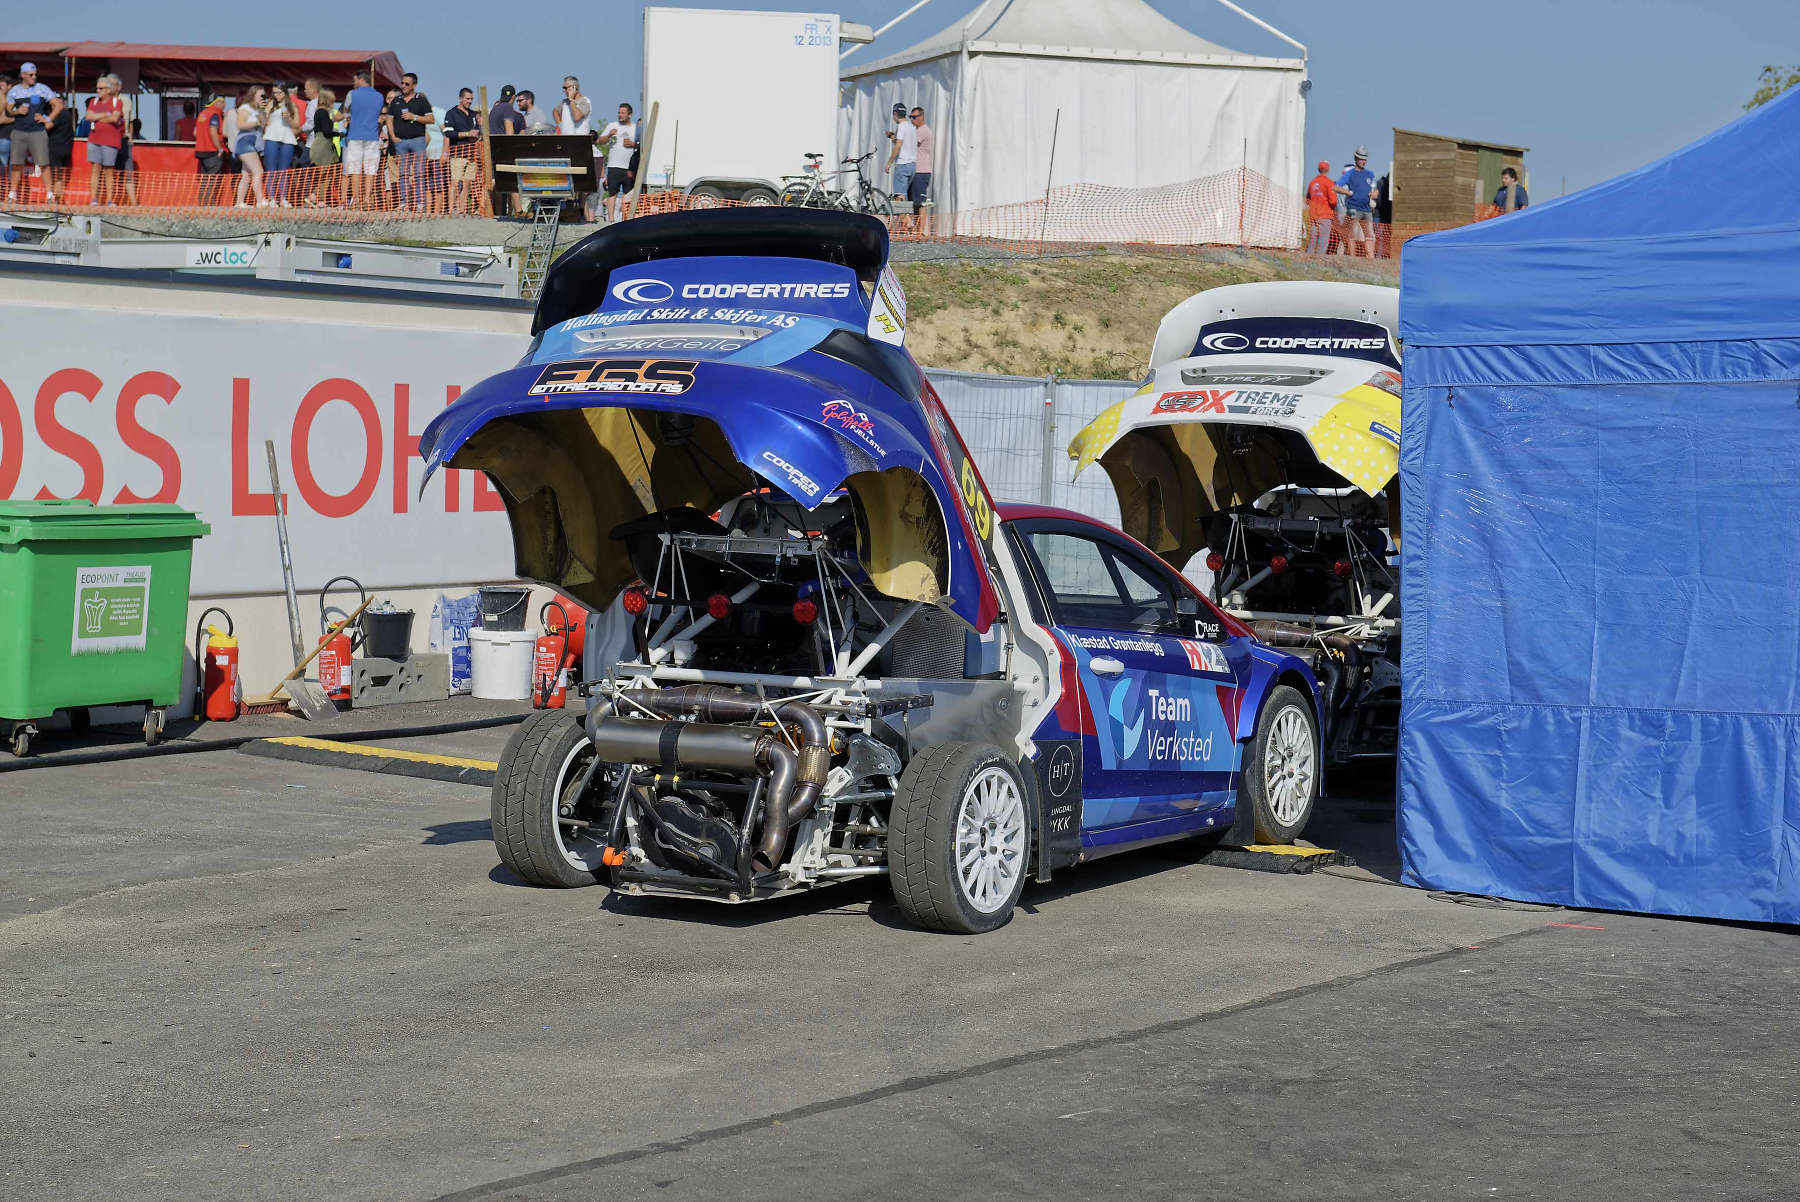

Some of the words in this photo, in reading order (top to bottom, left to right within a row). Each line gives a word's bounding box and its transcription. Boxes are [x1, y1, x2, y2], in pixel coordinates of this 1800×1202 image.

[681, 283, 851, 299] COOPERTIRES
[560, 308, 649, 333] Hallingdal
[650, 307, 692, 321] Skilt
[691, 308, 709, 320] &
[710, 309, 769, 325] Skifer
[767, 313, 800, 329] AS
[1255, 337, 1387, 349] COOPERTIRES
[533, 360, 699, 393] EGS
[850, 425, 887, 458] FJELLSTUE
[762, 451, 820, 492] COOPER
[788, 473, 816, 497] TIRES
[81, 573, 120, 584] ECOPOINT
[1068, 633, 1111, 650] Klæstad
[1148, 688, 1191, 722] Team
[1147, 729, 1213, 761] Verksted
